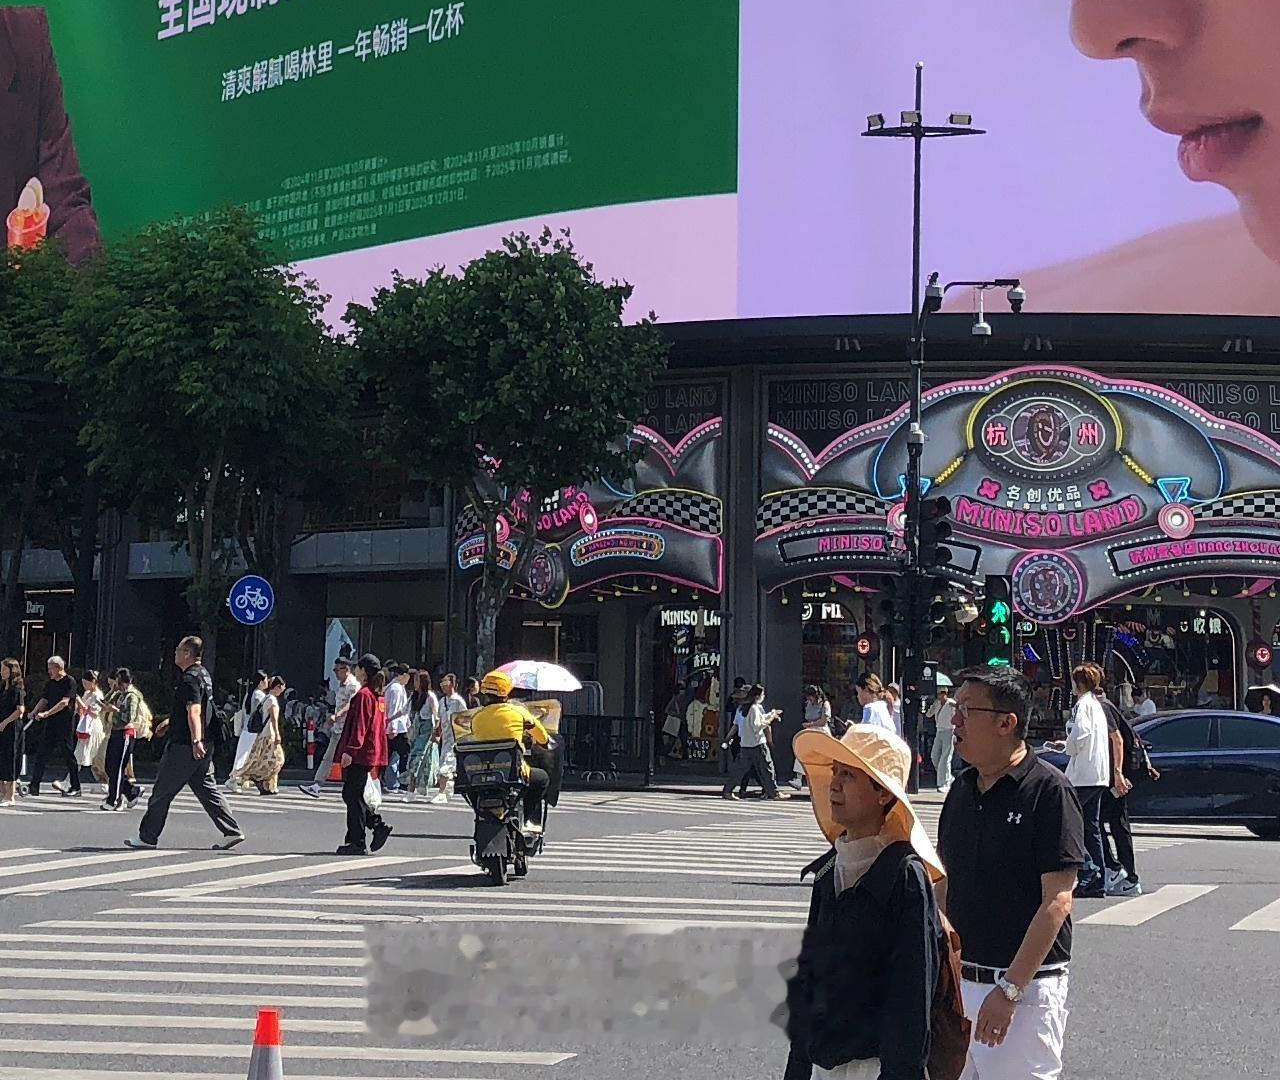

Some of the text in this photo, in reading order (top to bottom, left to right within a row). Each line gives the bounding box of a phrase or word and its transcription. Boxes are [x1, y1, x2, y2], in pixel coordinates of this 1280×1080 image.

[221, 2, 465, 102] 清爽解腻喝林里 一年畅销一亿杯
[866, 381, 931, 402] LAN
[986, 422, 1099, 447] 杭 州
[1006, 485, 1081, 502] 名创优品
[955, 497, 1140, 537] MINISO LAND
[818, 534, 884, 553] MINISO
[661, 610, 698, 626] MINISO
